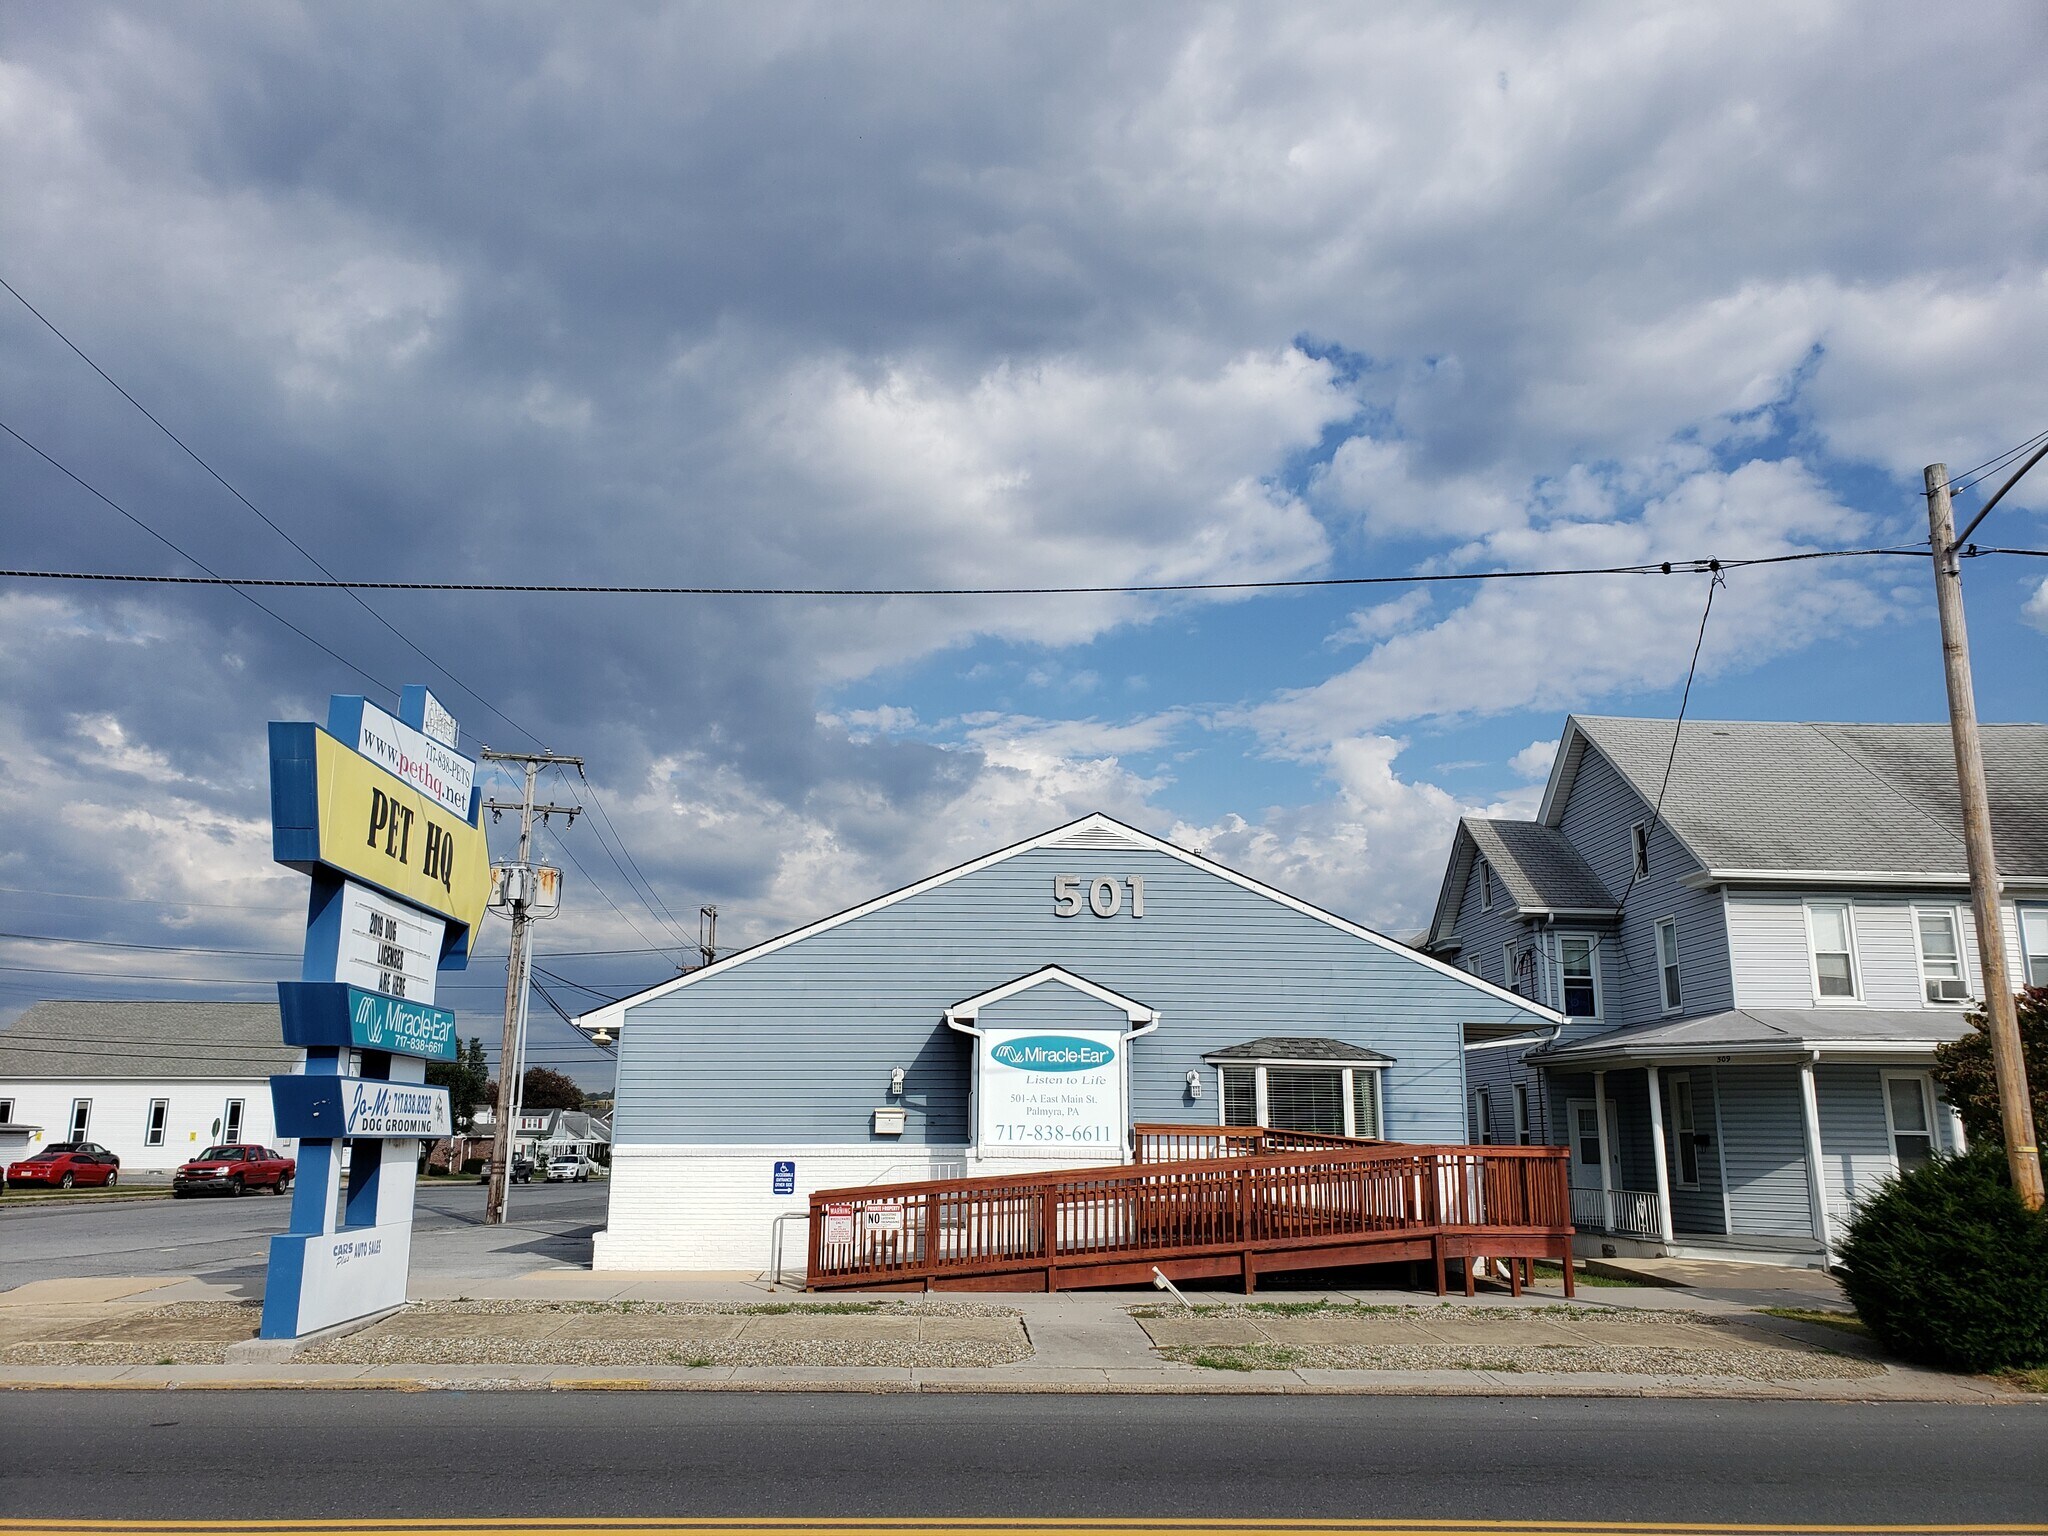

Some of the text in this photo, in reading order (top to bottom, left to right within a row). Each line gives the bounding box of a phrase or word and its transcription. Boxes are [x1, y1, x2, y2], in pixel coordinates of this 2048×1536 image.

[364, 729, 467, 812] www.pethq.net
[426, 742, 470, 788] 717-838-PETS
[367, 786, 453, 894] PET HQ
[1053, 874, 1144, 919] 501
[369, 912, 397, 942] 2019 DOG
[377, 943, 404, 971] LICENSES
[379, 973, 406, 998] ARE HERE
[394, 1034, 444, 1055] 717-838-6611
[1026, 1075, 1107, 1086] Listen to Life
[393, 1092, 432, 1115] 717.838.8292
[1010, 1094, 1098, 1104] 501-A East Main St.
[1026, 1106, 1080, 1118] Palmyra, PA
[362, 1118, 432, 1133] DOG GROOMING
[995, 1124, 1110, 1142] 717-838-6611
[829, 1207, 851, 1215] WARNING
[868, 1213, 880, 1224] NO
[333, 1239, 382, 1258] CARS AUTO SALES
